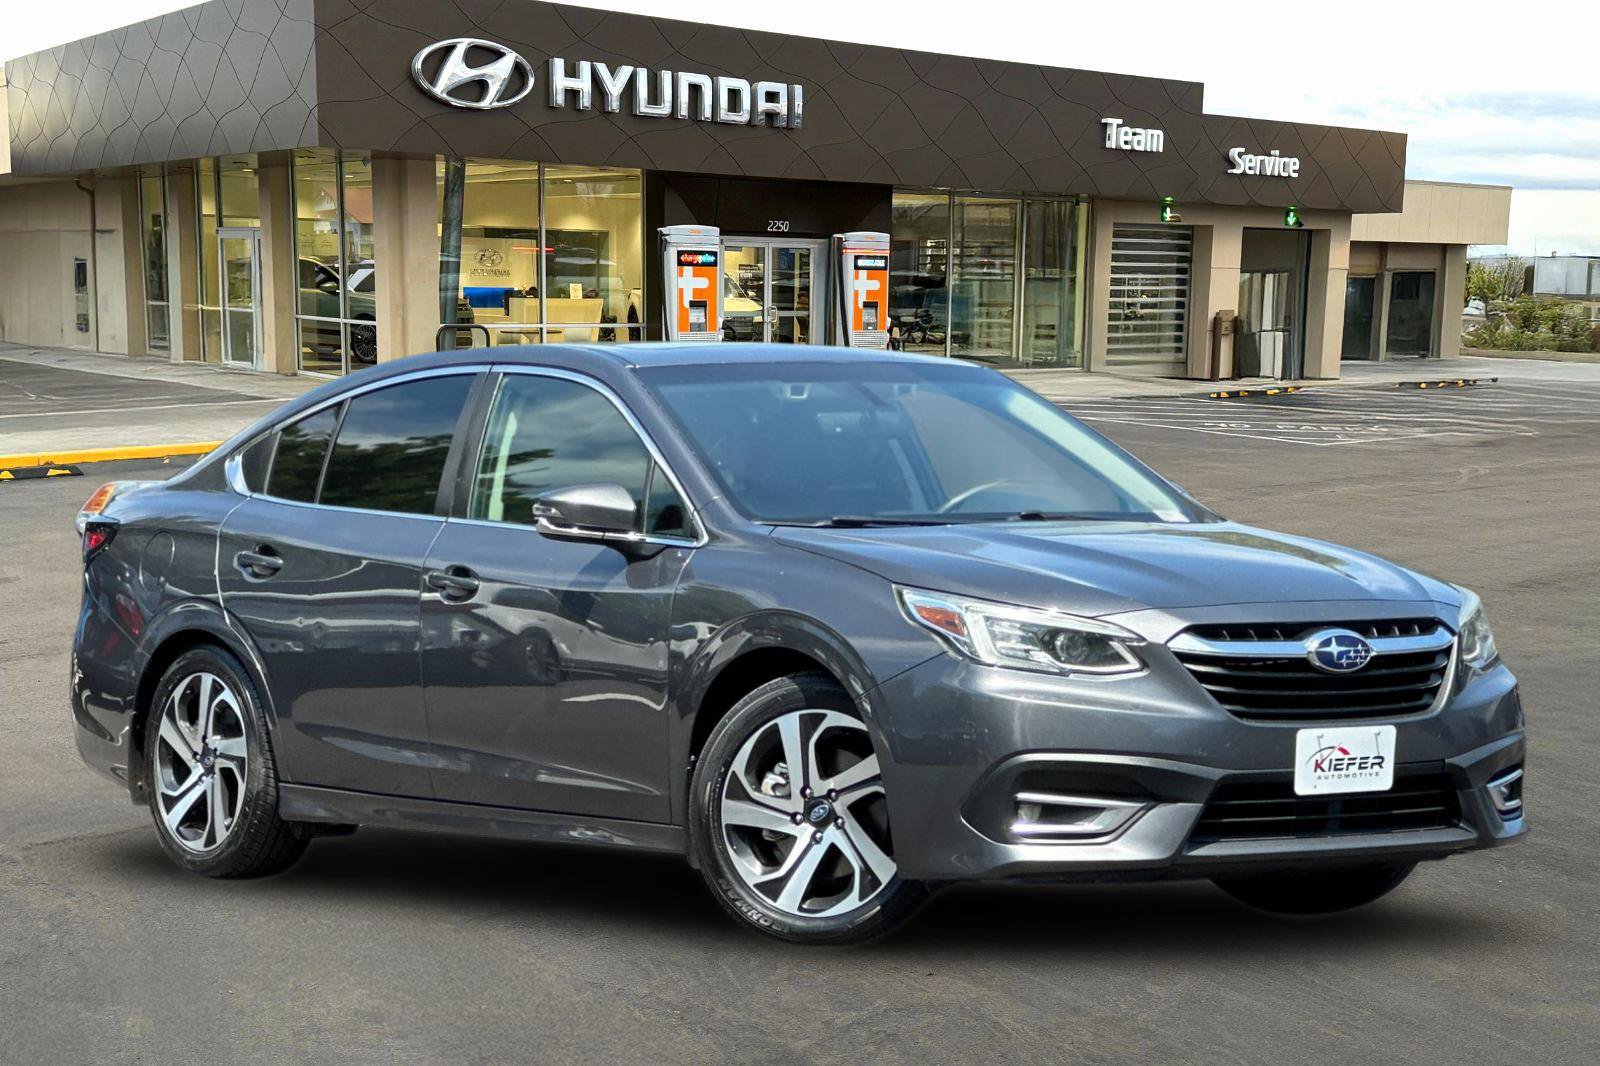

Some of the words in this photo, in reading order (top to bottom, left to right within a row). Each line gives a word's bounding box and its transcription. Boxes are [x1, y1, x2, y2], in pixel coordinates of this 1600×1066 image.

[548, 57, 804, 129] HYUNDAI
[1101, 117, 1165, 153] Team
[1227, 147, 1301, 178] Service
[767, 220, 790, 232] 2250
[1314, 755, 1386, 772] KIEFER
[1317, 771, 1380, 780] AUTOMOTIVE
